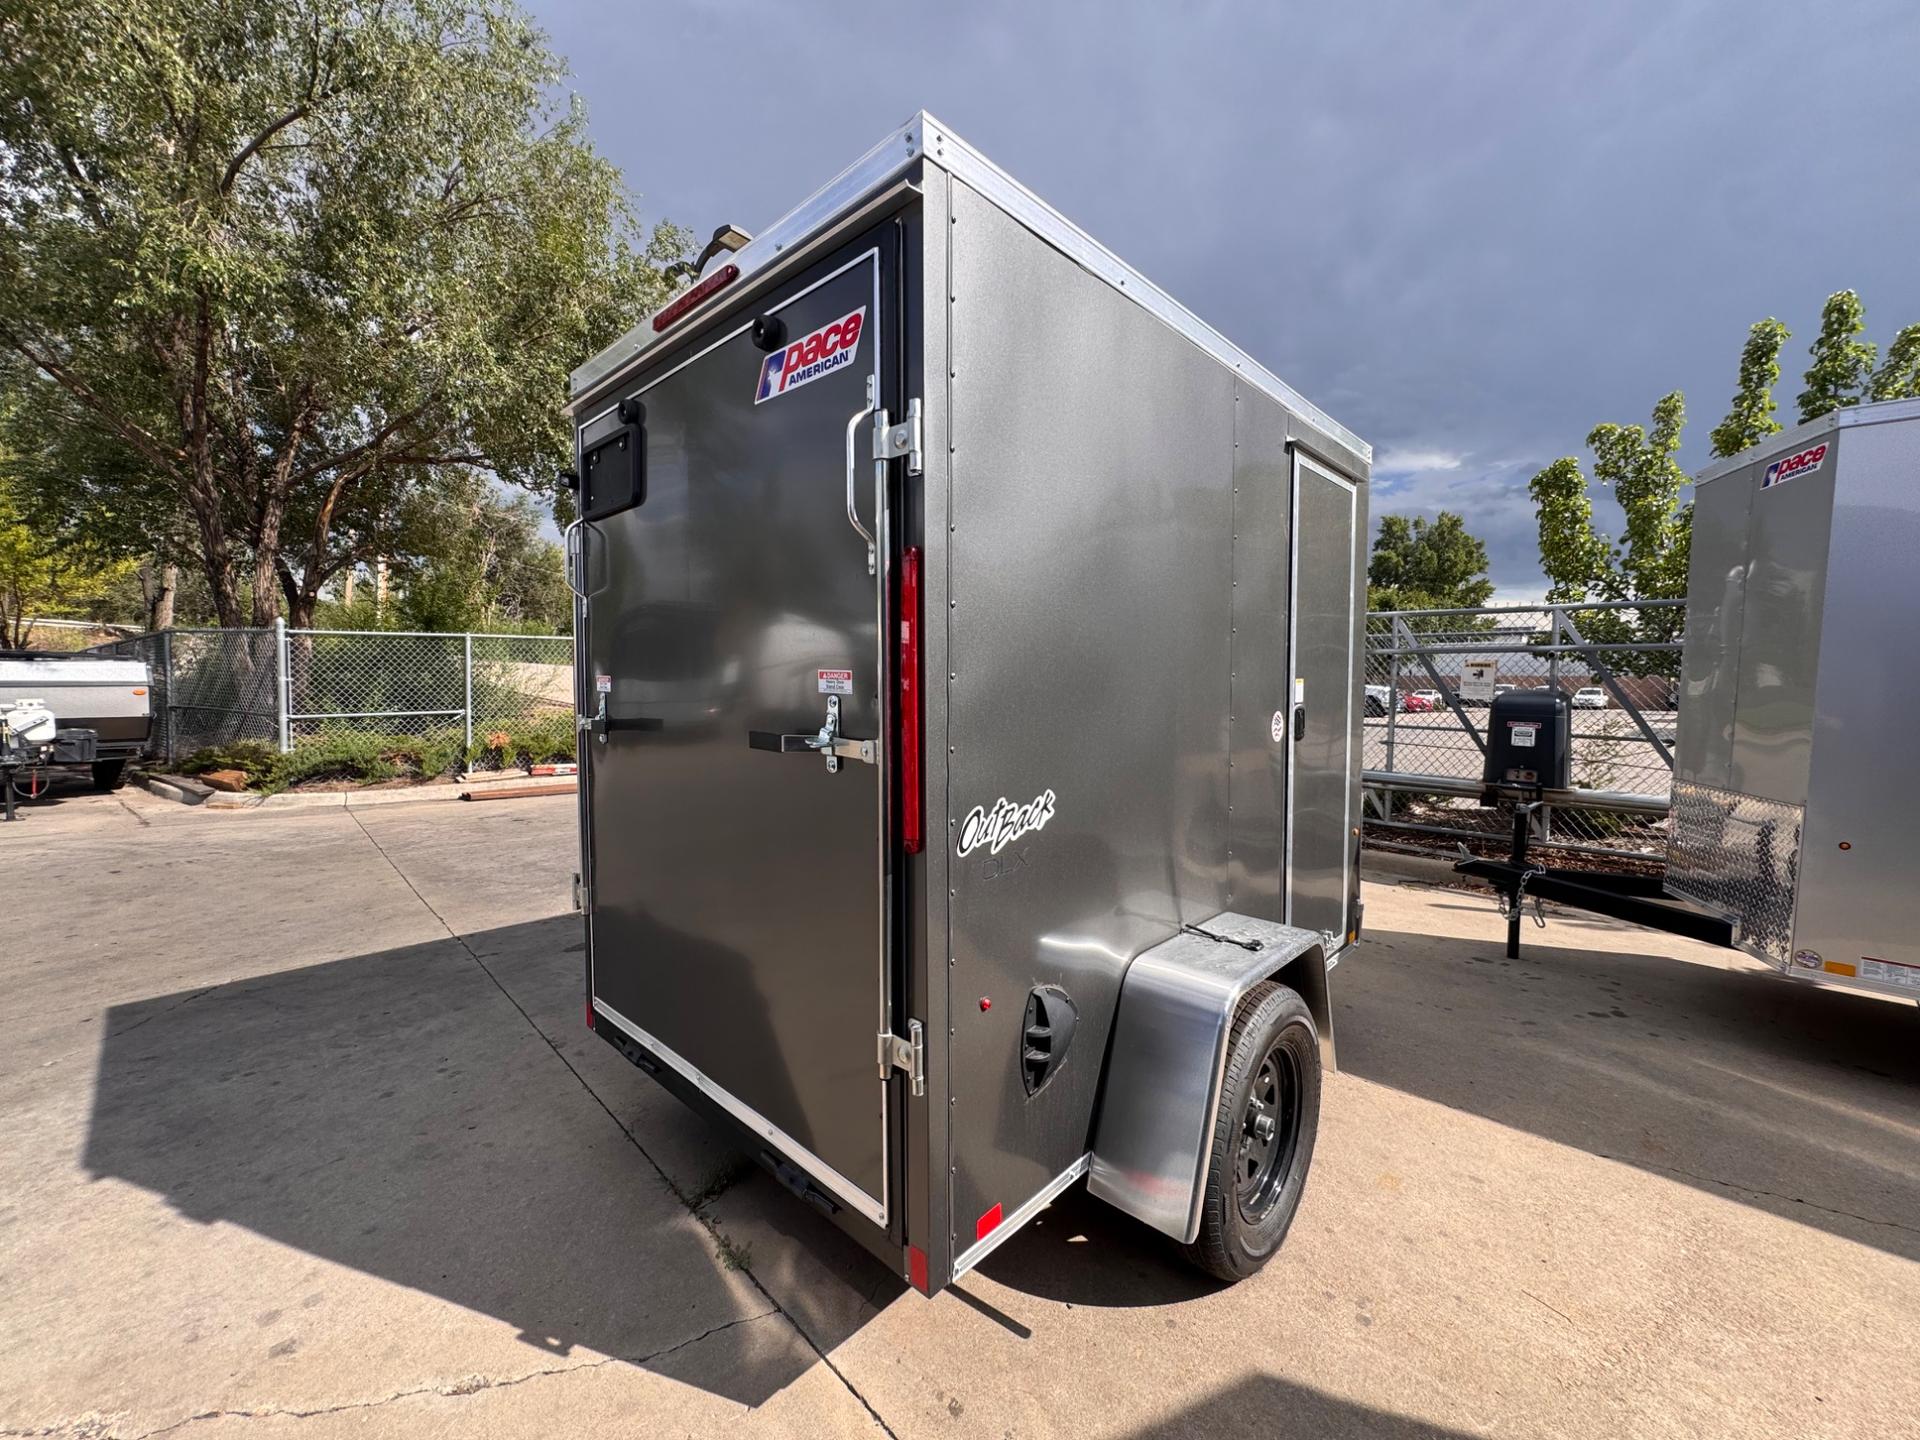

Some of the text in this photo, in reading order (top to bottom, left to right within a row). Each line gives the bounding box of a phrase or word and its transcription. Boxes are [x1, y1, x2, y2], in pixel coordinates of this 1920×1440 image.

[779, 313, 862, 392] pace
[789, 351, 848, 386] AMERICAN
[1775, 445, 1826, 484] pace
[1781, 463, 1817, 480] AMERICAN
